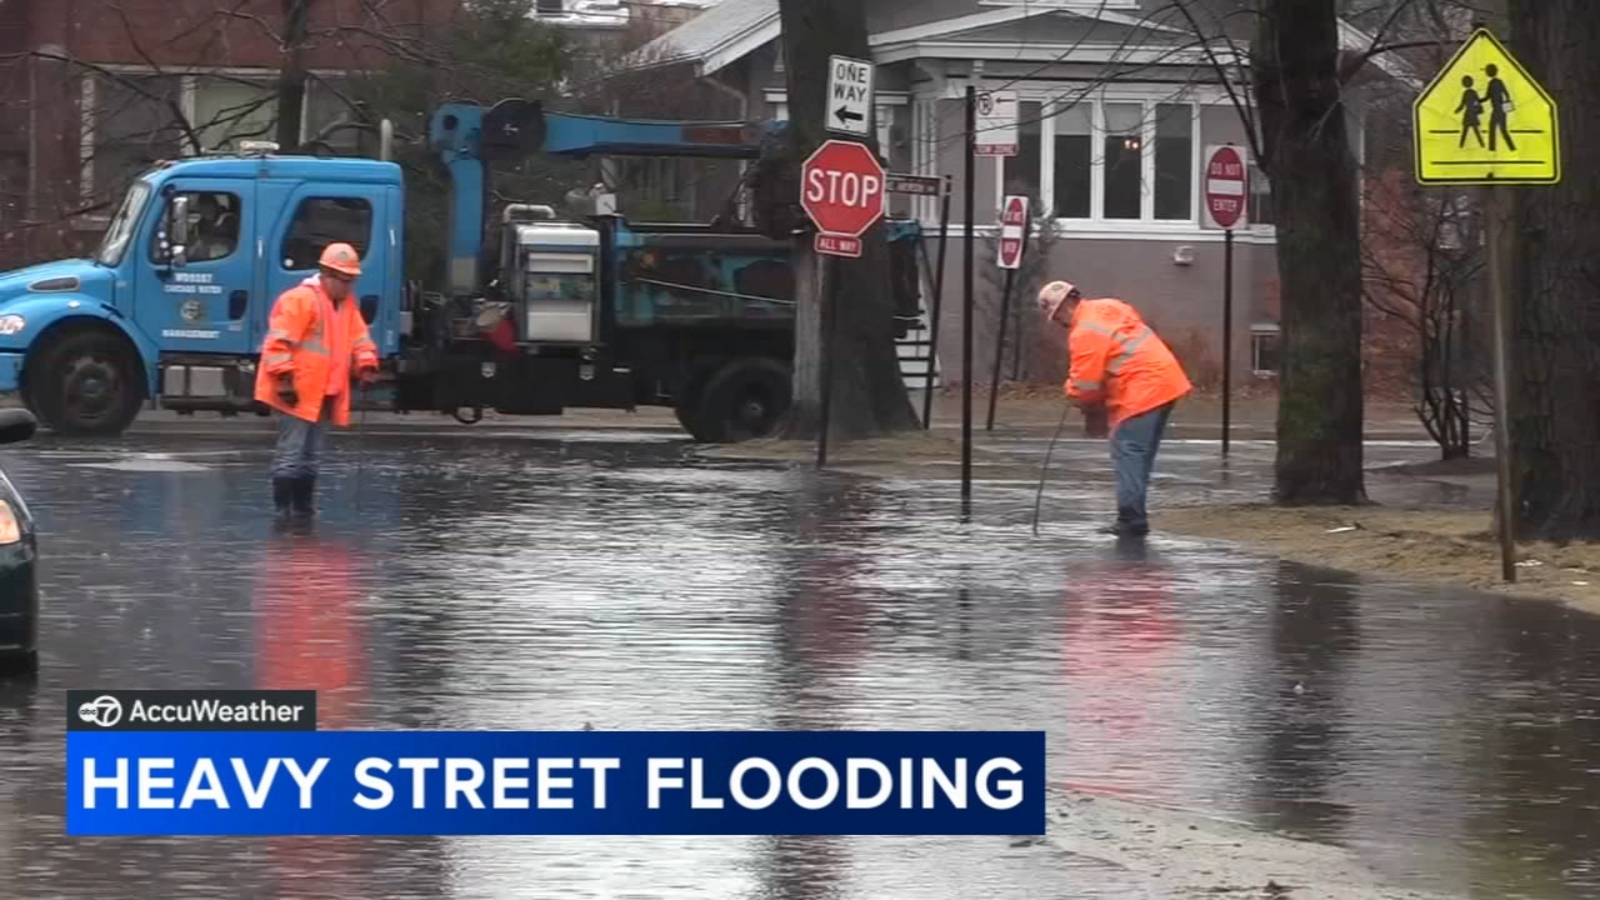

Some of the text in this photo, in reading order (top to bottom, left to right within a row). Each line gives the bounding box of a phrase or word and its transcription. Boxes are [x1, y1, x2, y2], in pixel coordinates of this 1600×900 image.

[836, 63, 867, 84] ONE
[834, 83, 867, 102] WAY
[1210, 162, 1241, 176] DO NOT
[806, 168, 879, 208] STOP
[1213, 199, 1237, 212] ENTER
[819, 237, 856, 252] ALL WAY
